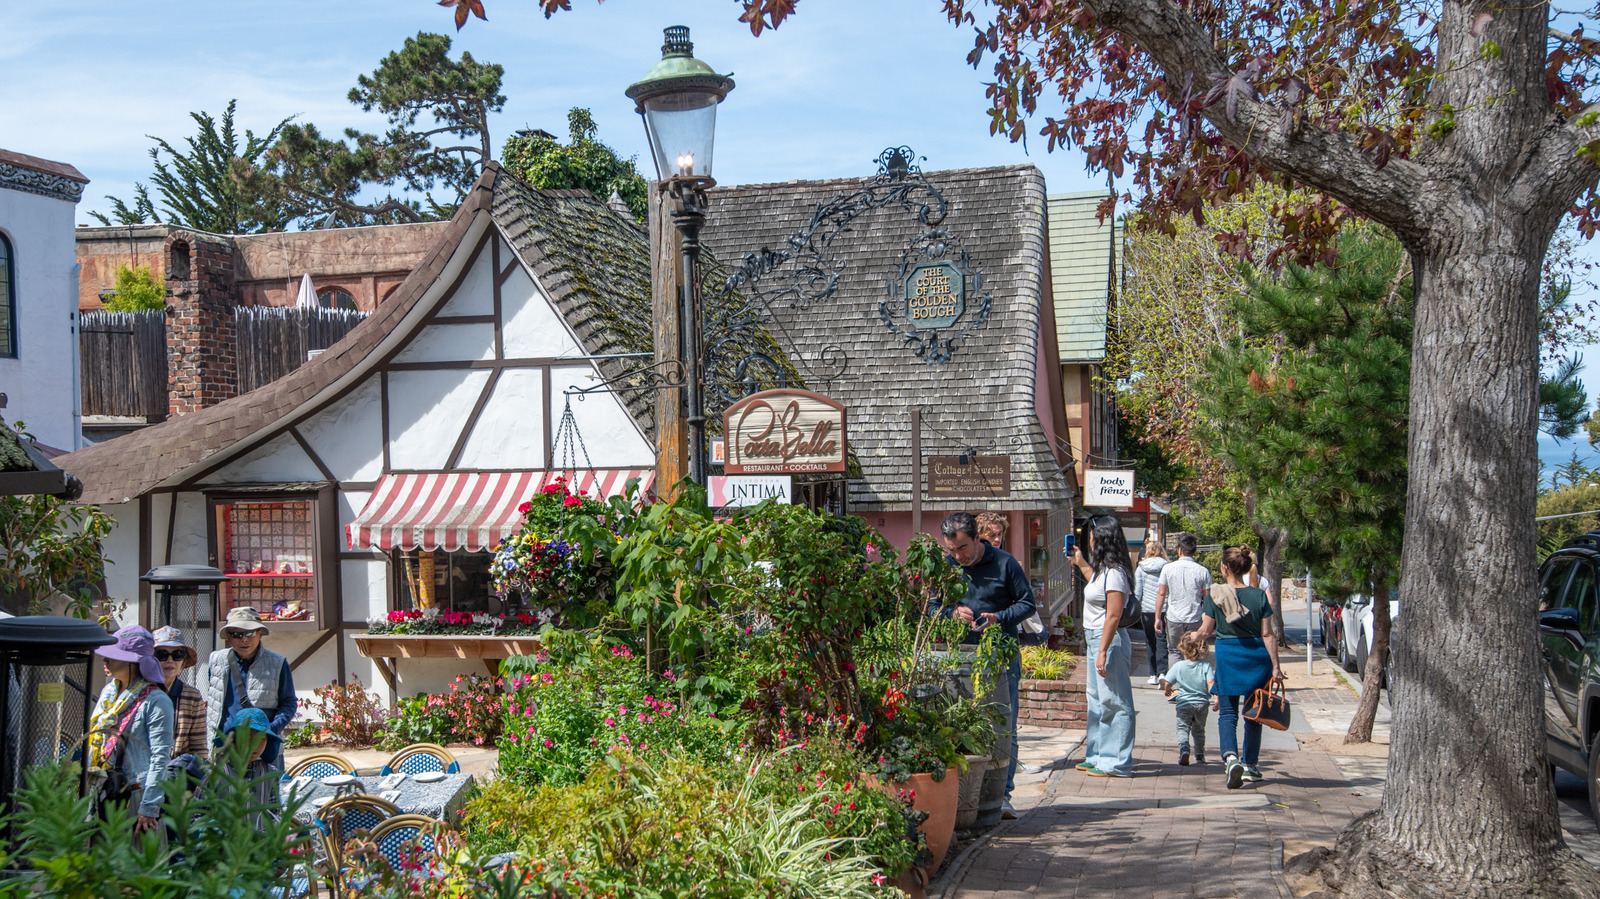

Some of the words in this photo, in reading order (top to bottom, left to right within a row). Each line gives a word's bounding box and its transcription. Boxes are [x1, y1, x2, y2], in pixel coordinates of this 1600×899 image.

[923, 267, 943, 277] THE
[916, 276, 949, 287] COURT
[915, 287, 928, 296] OF
[931, 284, 951, 294] THE
[909, 294, 958, 308] GOLDEN
[913, 305, 956, 319] BOUGH
[743, 464, 784, 472] RESTAURANT
[789, 463, 828, 471] COCKTAILS
[1100, 476, 1125, 487] body
[732, 484, 786, 498] INTIMA
